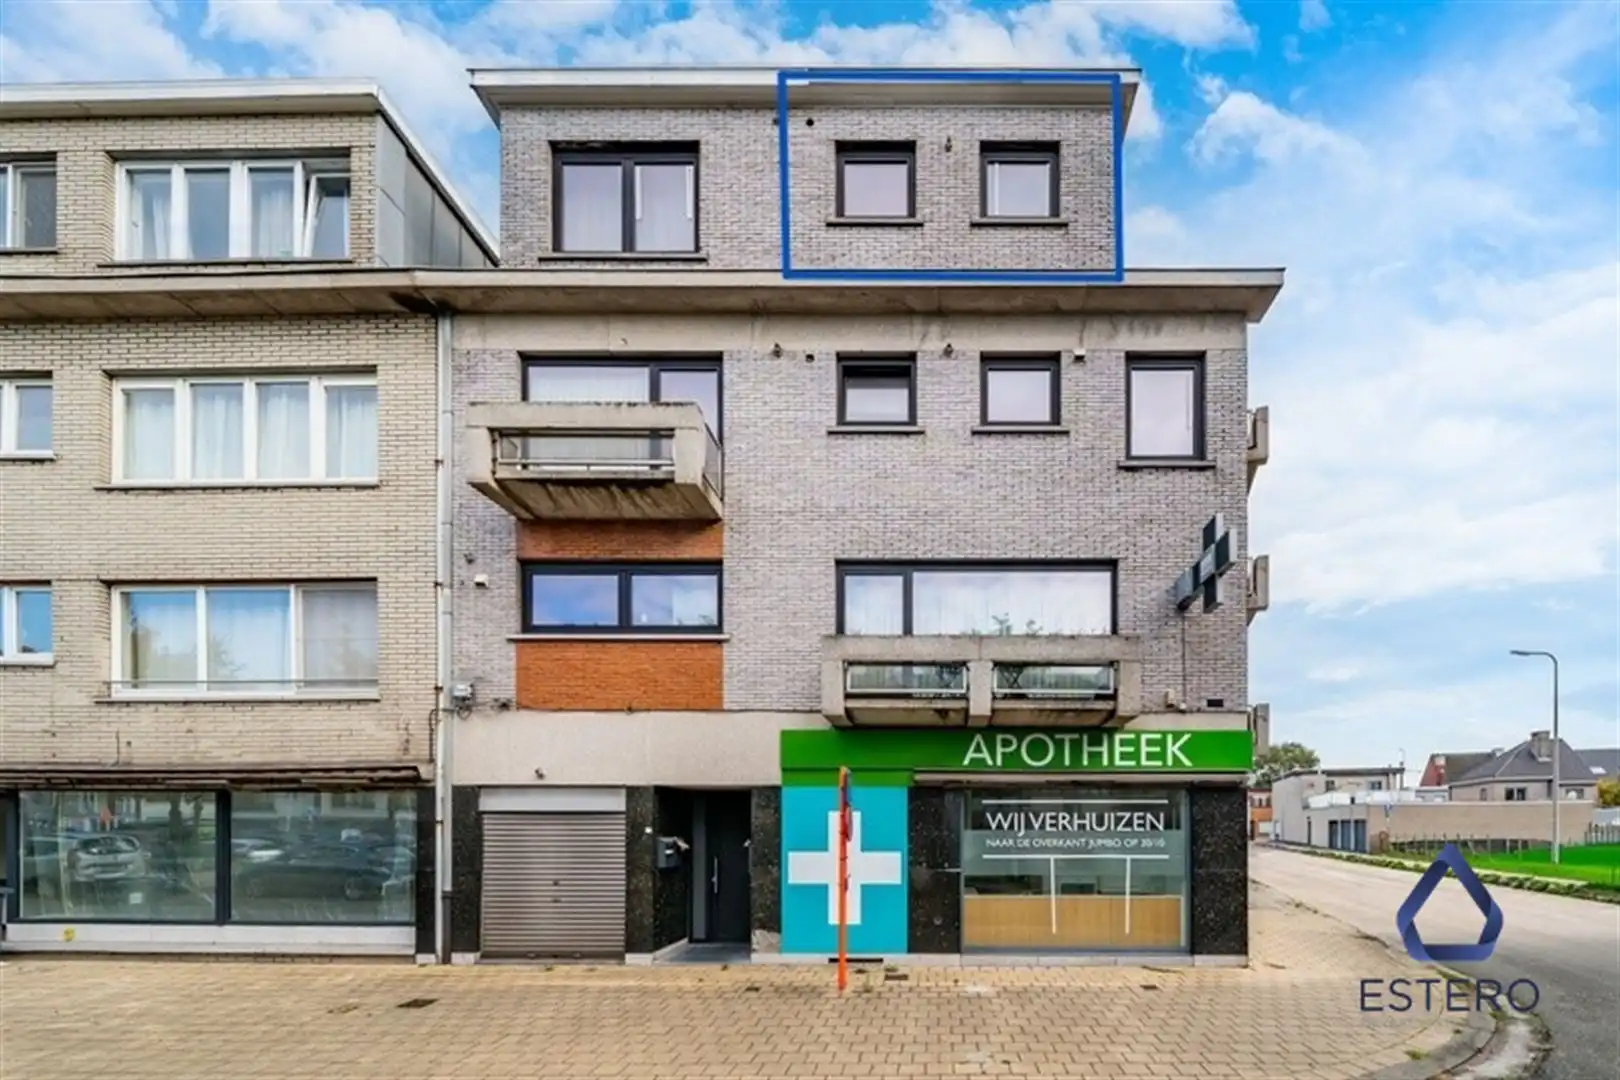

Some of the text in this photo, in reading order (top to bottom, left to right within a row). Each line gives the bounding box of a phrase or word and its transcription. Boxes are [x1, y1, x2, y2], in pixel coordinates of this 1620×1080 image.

[962, 733, 1193, 767] APOTHEEK
[985, 811, 1164, 837] WIJ VERHUIZEN
[985, 838, 1015, 848] NAAR
[1016, 838, 1030, 848] DE
[1032, 838, 1086, 848] OVERKANT
[1087, 838, 1121, 849] JUMBO
[1123, 838, 1139, 848] OP
